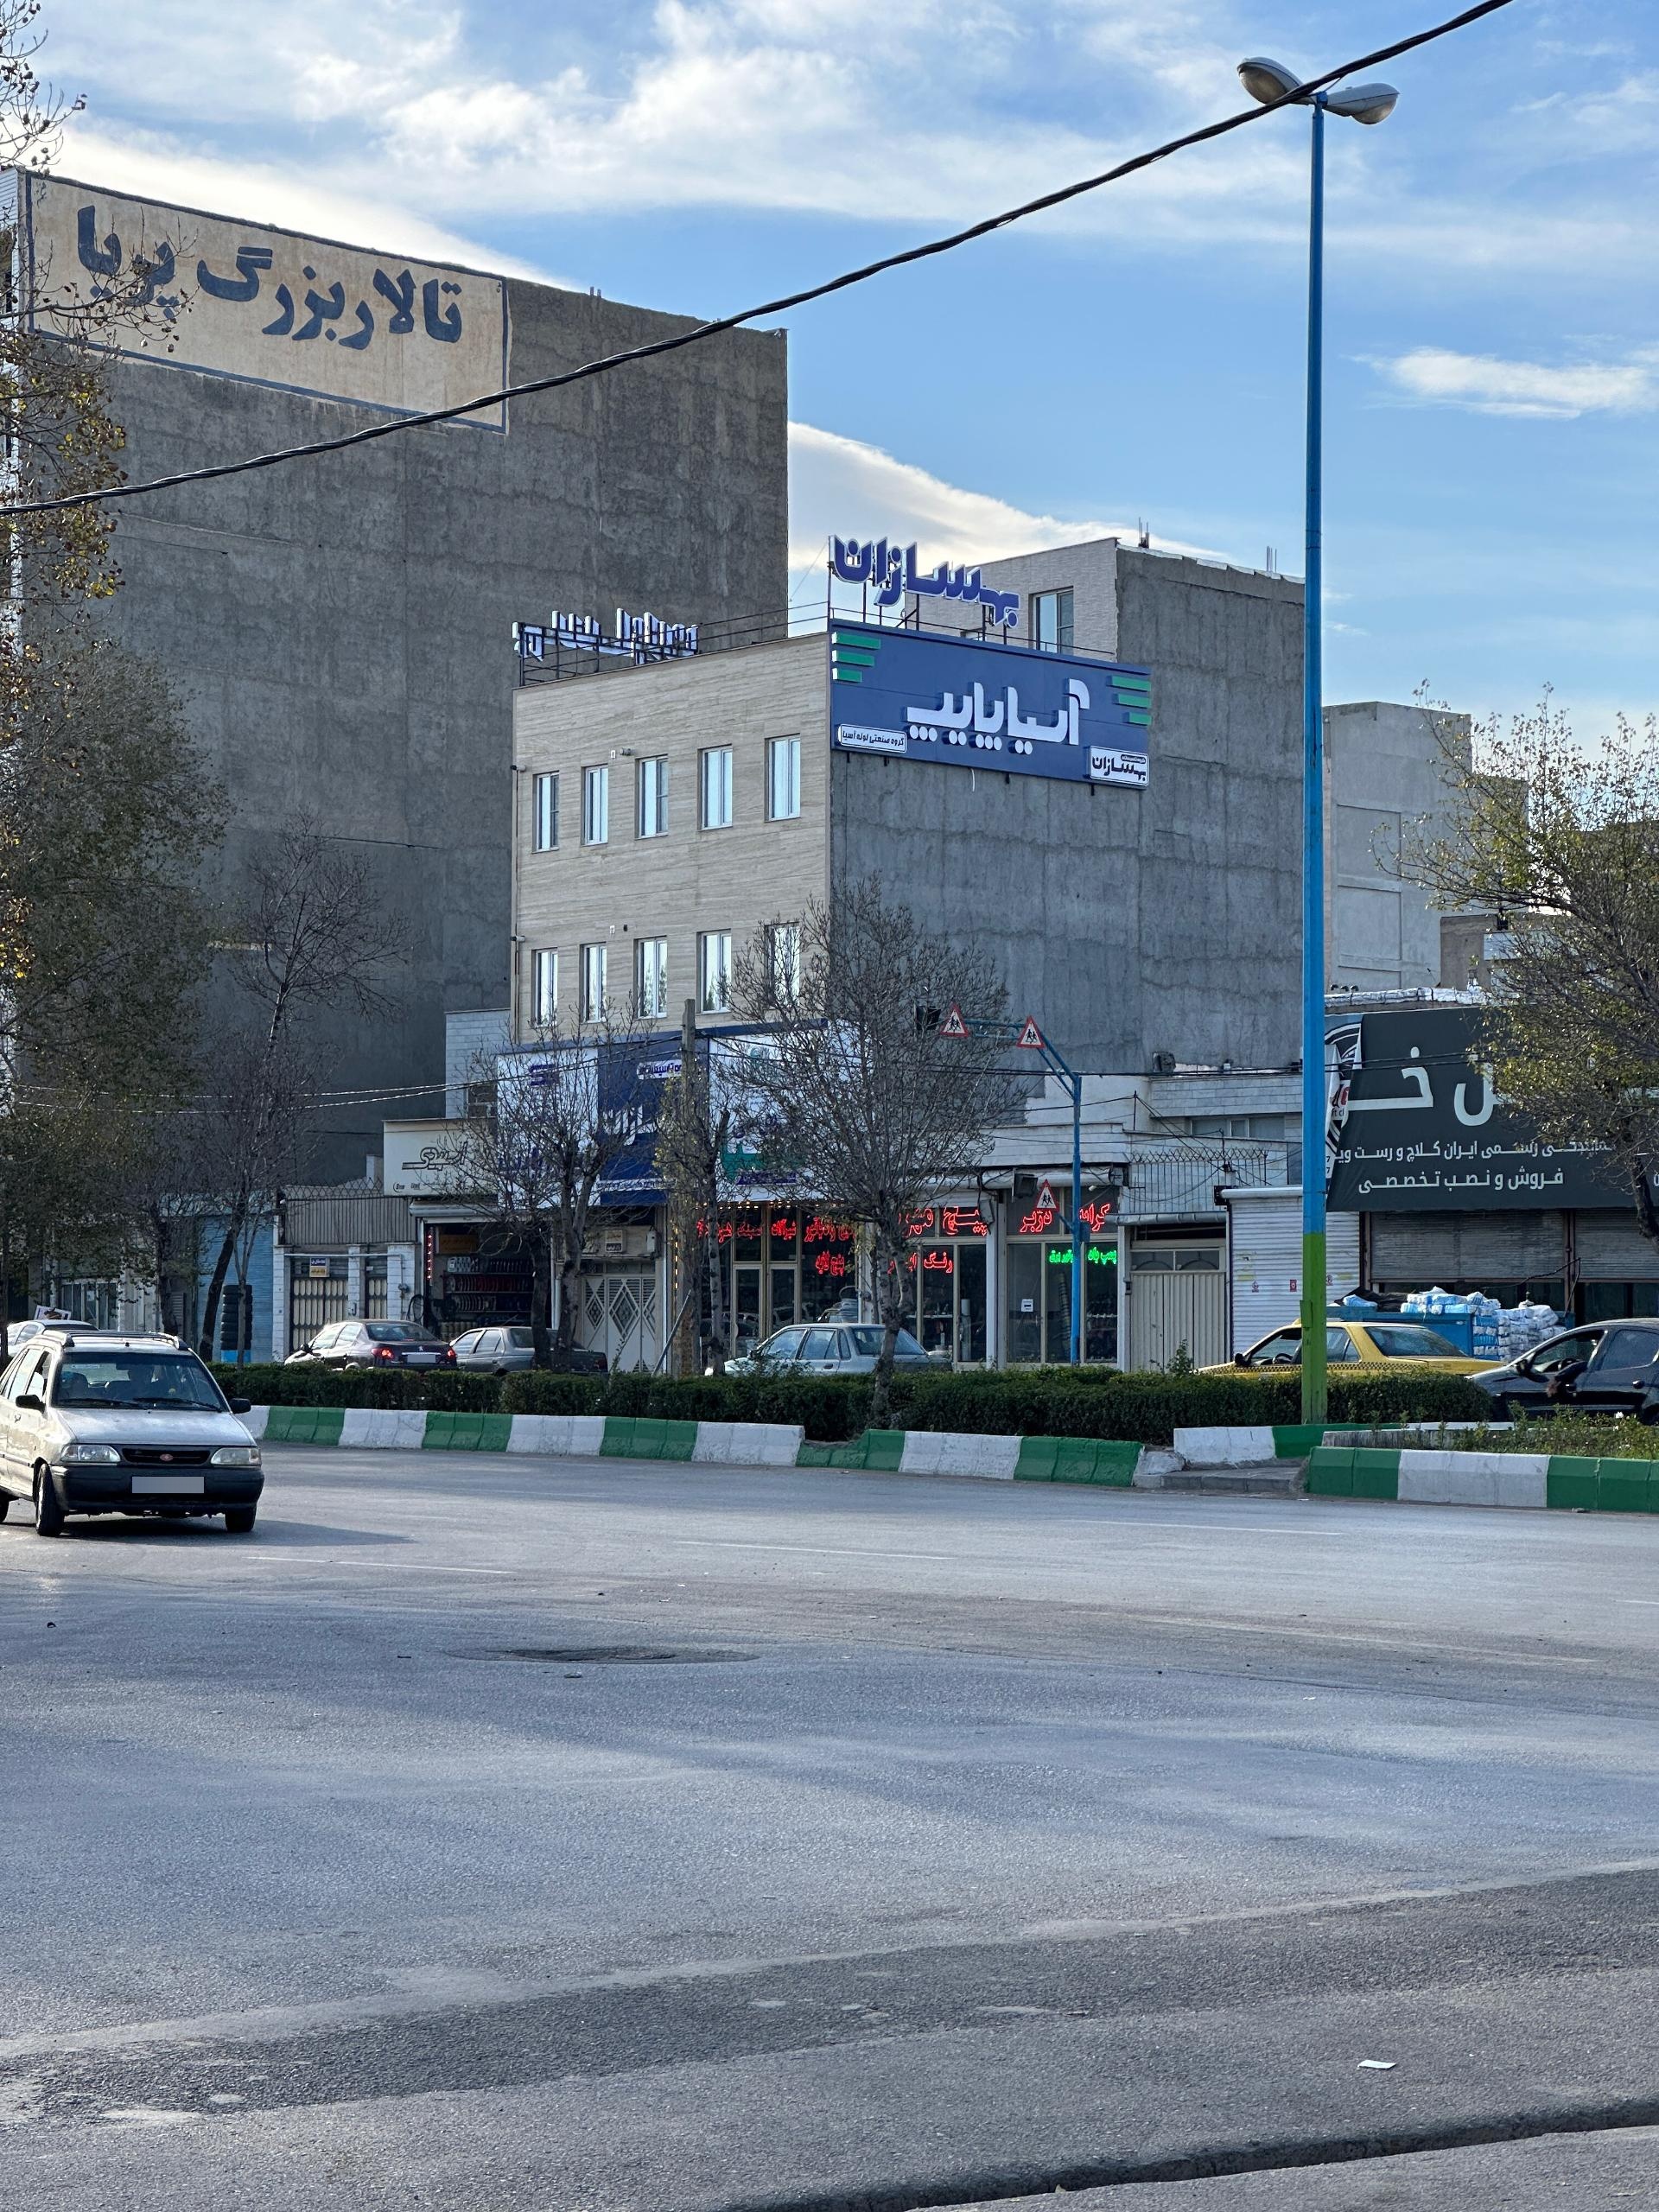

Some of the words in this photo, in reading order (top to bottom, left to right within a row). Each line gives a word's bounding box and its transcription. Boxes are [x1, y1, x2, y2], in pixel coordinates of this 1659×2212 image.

[197, 246, 345, 341] بزرگ
[339, 269, 462, 350] تالار
[831, 535, 1020, 628] بهسازان
[1092, 756, 1146, 782] بهسازان
[1355, 1147, 1393, 1161] رست
[1396, 1147, 1403, 1161] و
[1407, 1141, 1440, 1162] کلاچ
[1444, 1141, 1477, 1160] ایران
[1358, 1170, 1440, 1194] تخصصی
[1445, 1170, 1491, 1192] نصب
[1495, 1173, 1503, 1190] و
[1508, 1166, 1564, 1190] فروش
